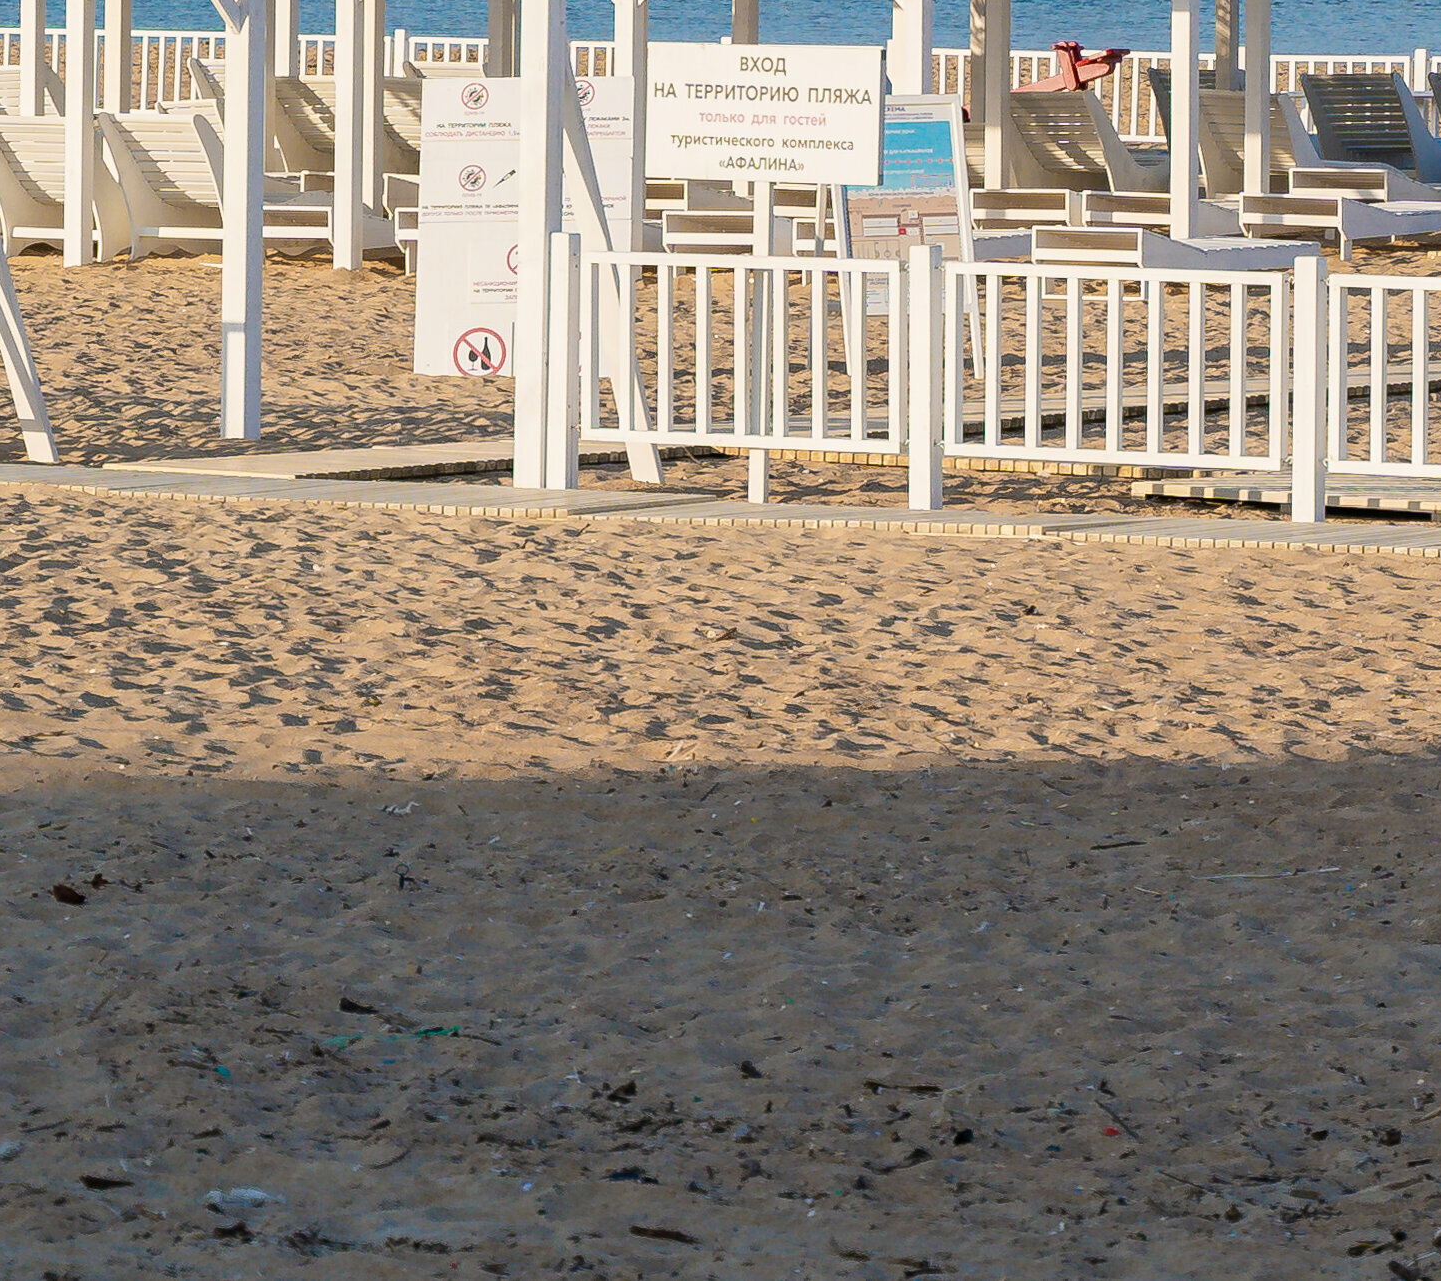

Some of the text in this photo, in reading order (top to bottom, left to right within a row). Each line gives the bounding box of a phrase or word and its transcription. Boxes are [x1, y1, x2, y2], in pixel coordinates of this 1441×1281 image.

[739, 56, 787, 76] ВХОД
[654, 82, 873, 105] НА ТЕРРИТОРИЮ ПЛЯЖА
[699, 112, 827, 127] только для гостей
[670, 134, 855, 151] туристического комплекса
[719, 156, 805, 171] «АФАЛИНА»
